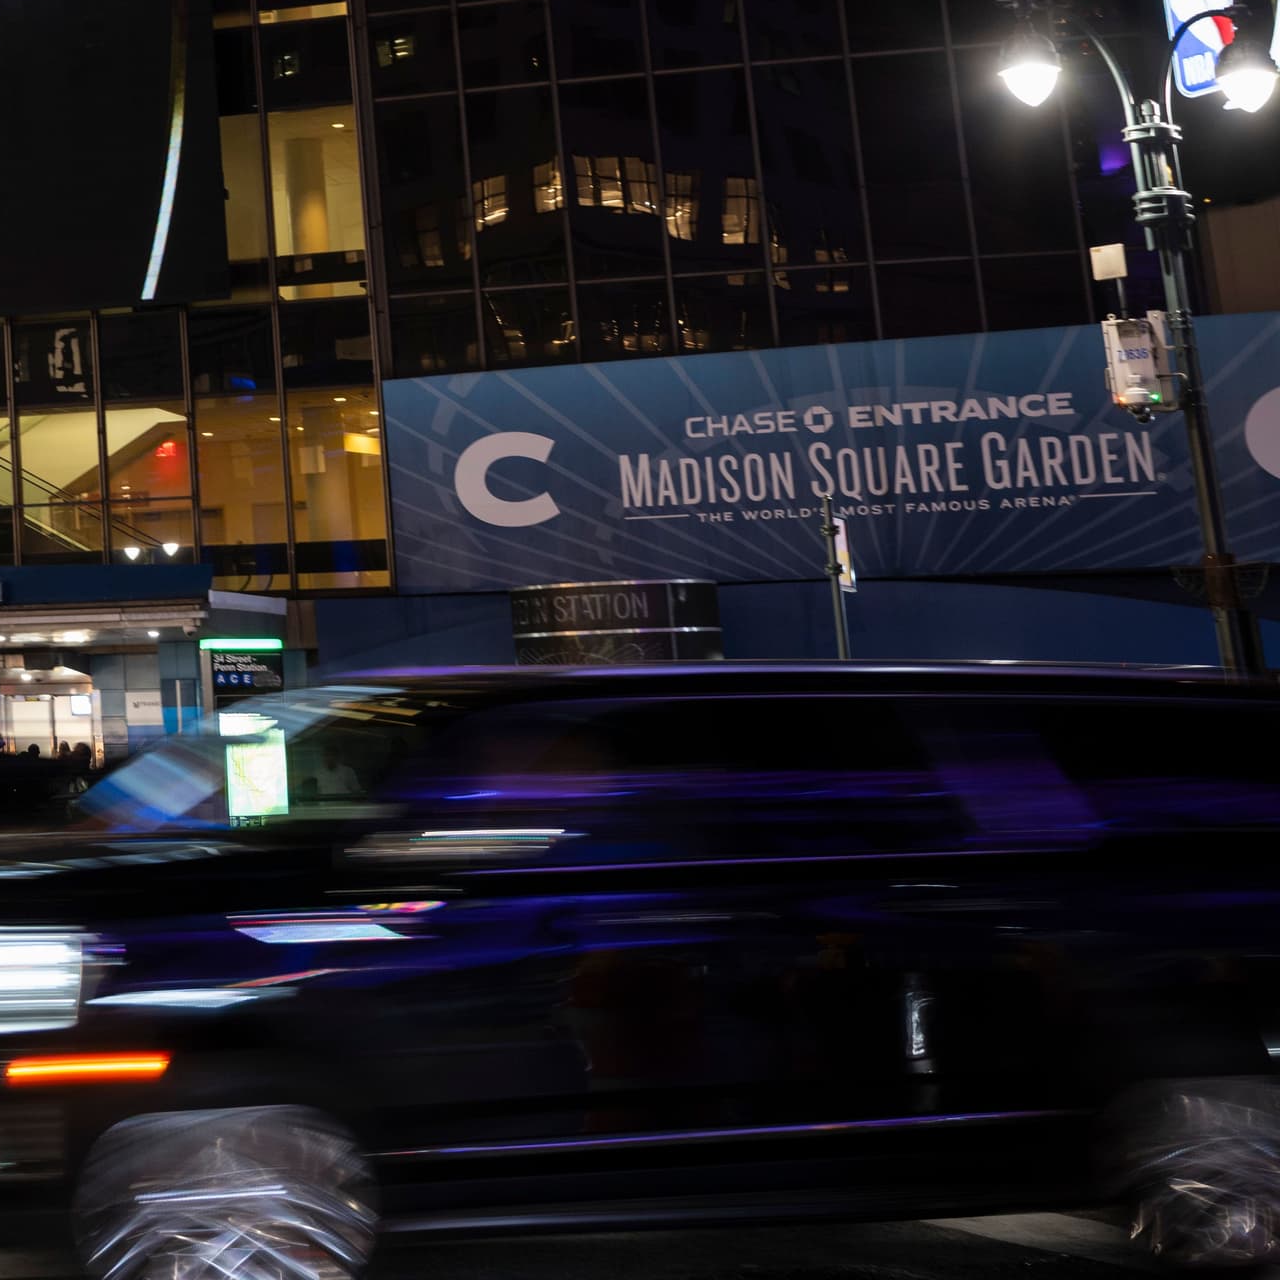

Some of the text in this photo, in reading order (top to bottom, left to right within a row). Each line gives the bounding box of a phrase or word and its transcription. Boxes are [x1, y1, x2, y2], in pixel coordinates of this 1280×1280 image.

[685, 392, 1075, 438] CHASE ENTRANCE
[454, 431, 560, 526] C
[619, 431, 1156, 508] MADISON SQUARE GARDEN
[697, 496, 1072, 522] THE WORLD'S MOST FAMOUS ARENA
[213, 663, 268, 671] Penn Station
[226, 654, 251, 663] Street
